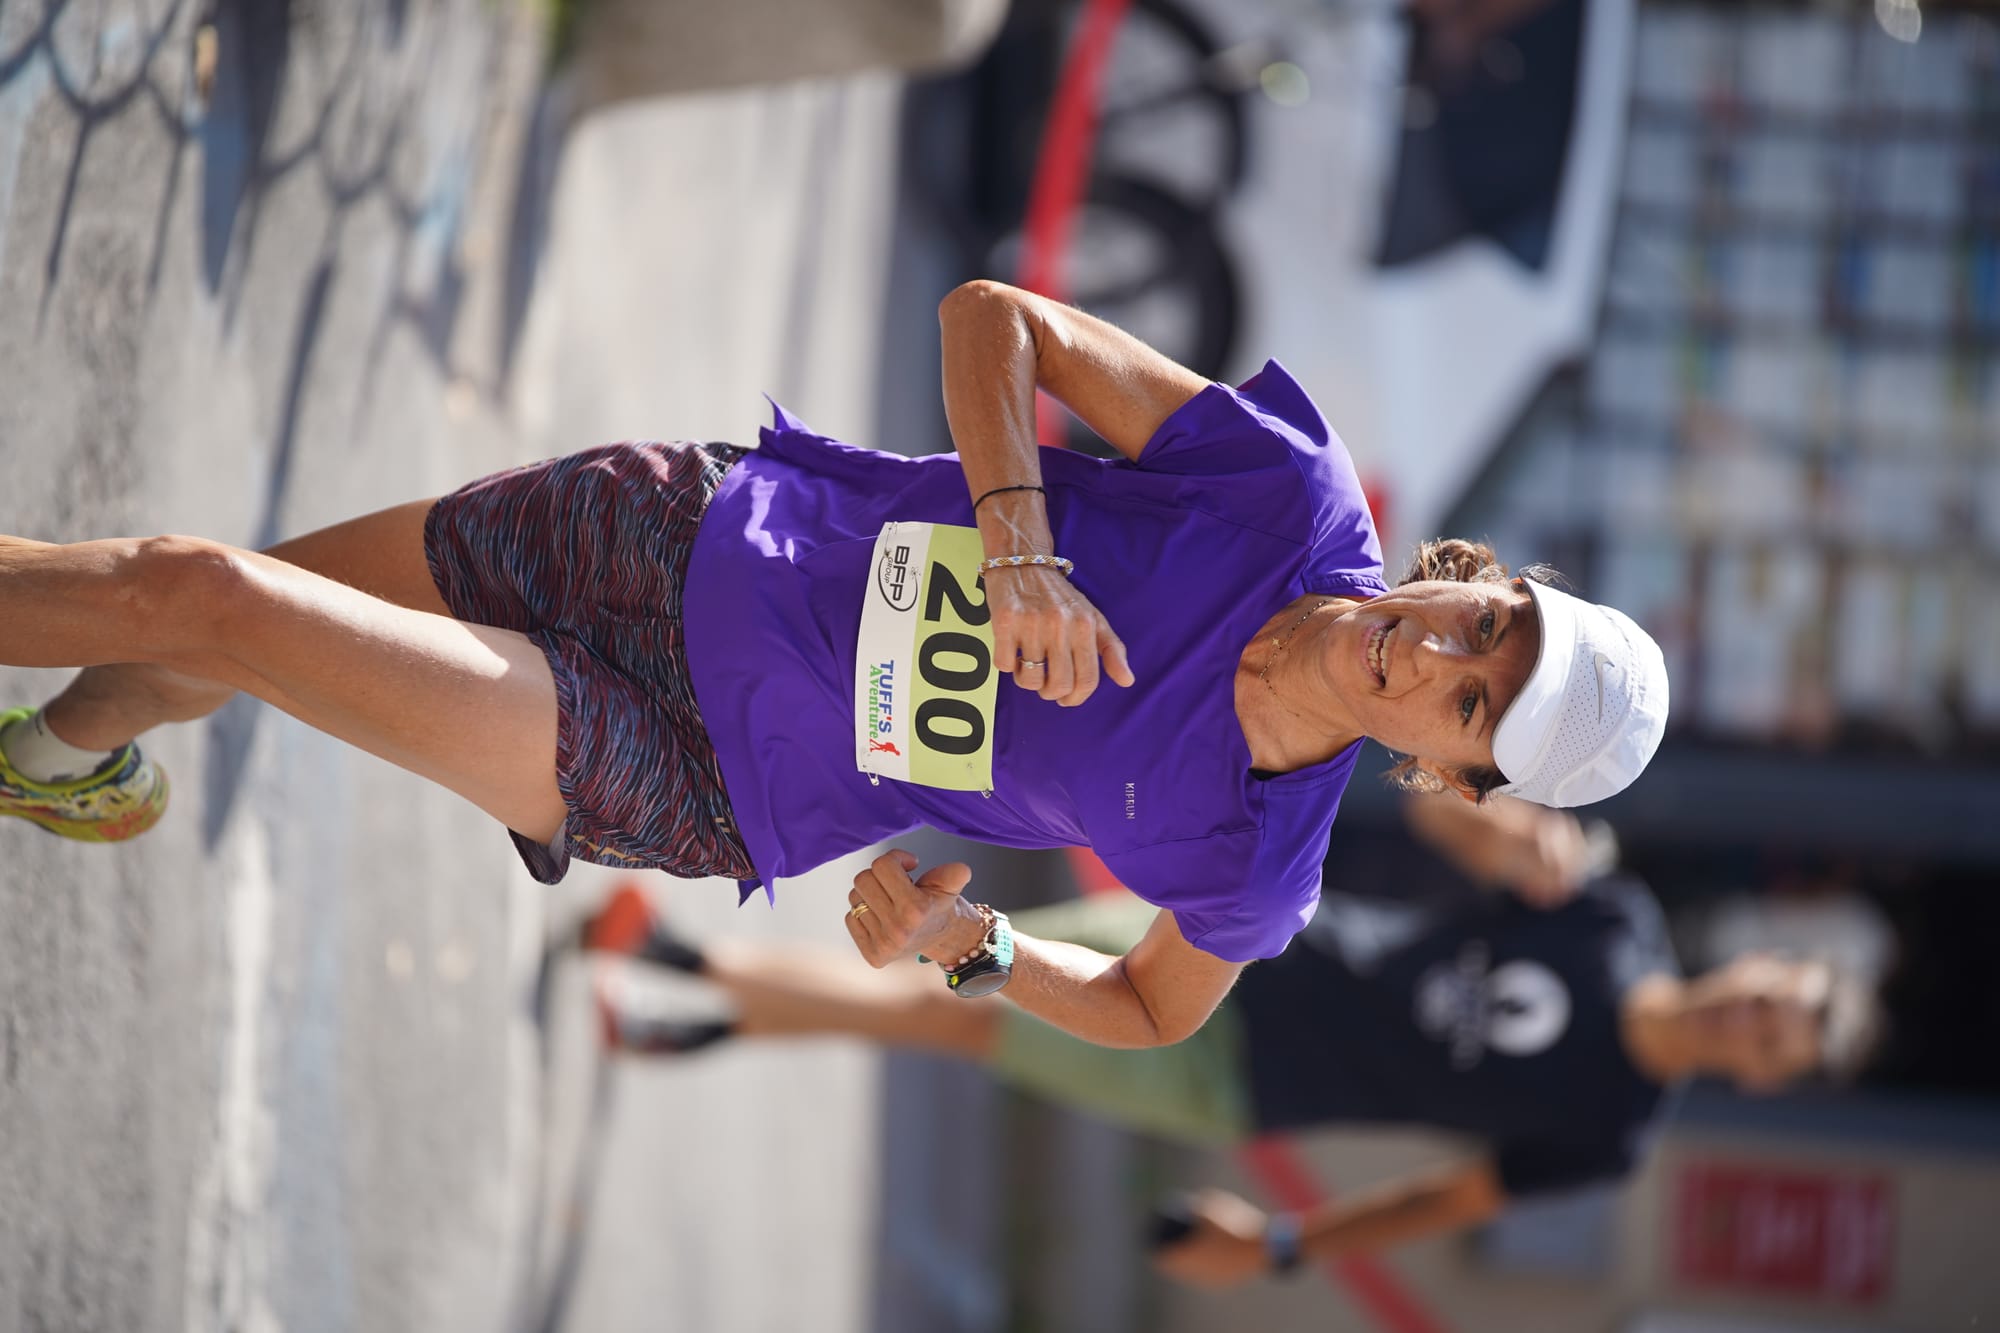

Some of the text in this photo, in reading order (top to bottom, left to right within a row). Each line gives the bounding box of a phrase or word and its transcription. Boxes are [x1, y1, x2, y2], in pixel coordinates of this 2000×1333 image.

[883, 556, 894, 584] GROUP
[890, 545, 910, 601] BFP
[915, 561, 991, 755] 200
[869, 663, 883, 739] Aventure
[878, 659, 894, 734] TUFF'S
[1125, 782, 1136, 820] KIPRUN
